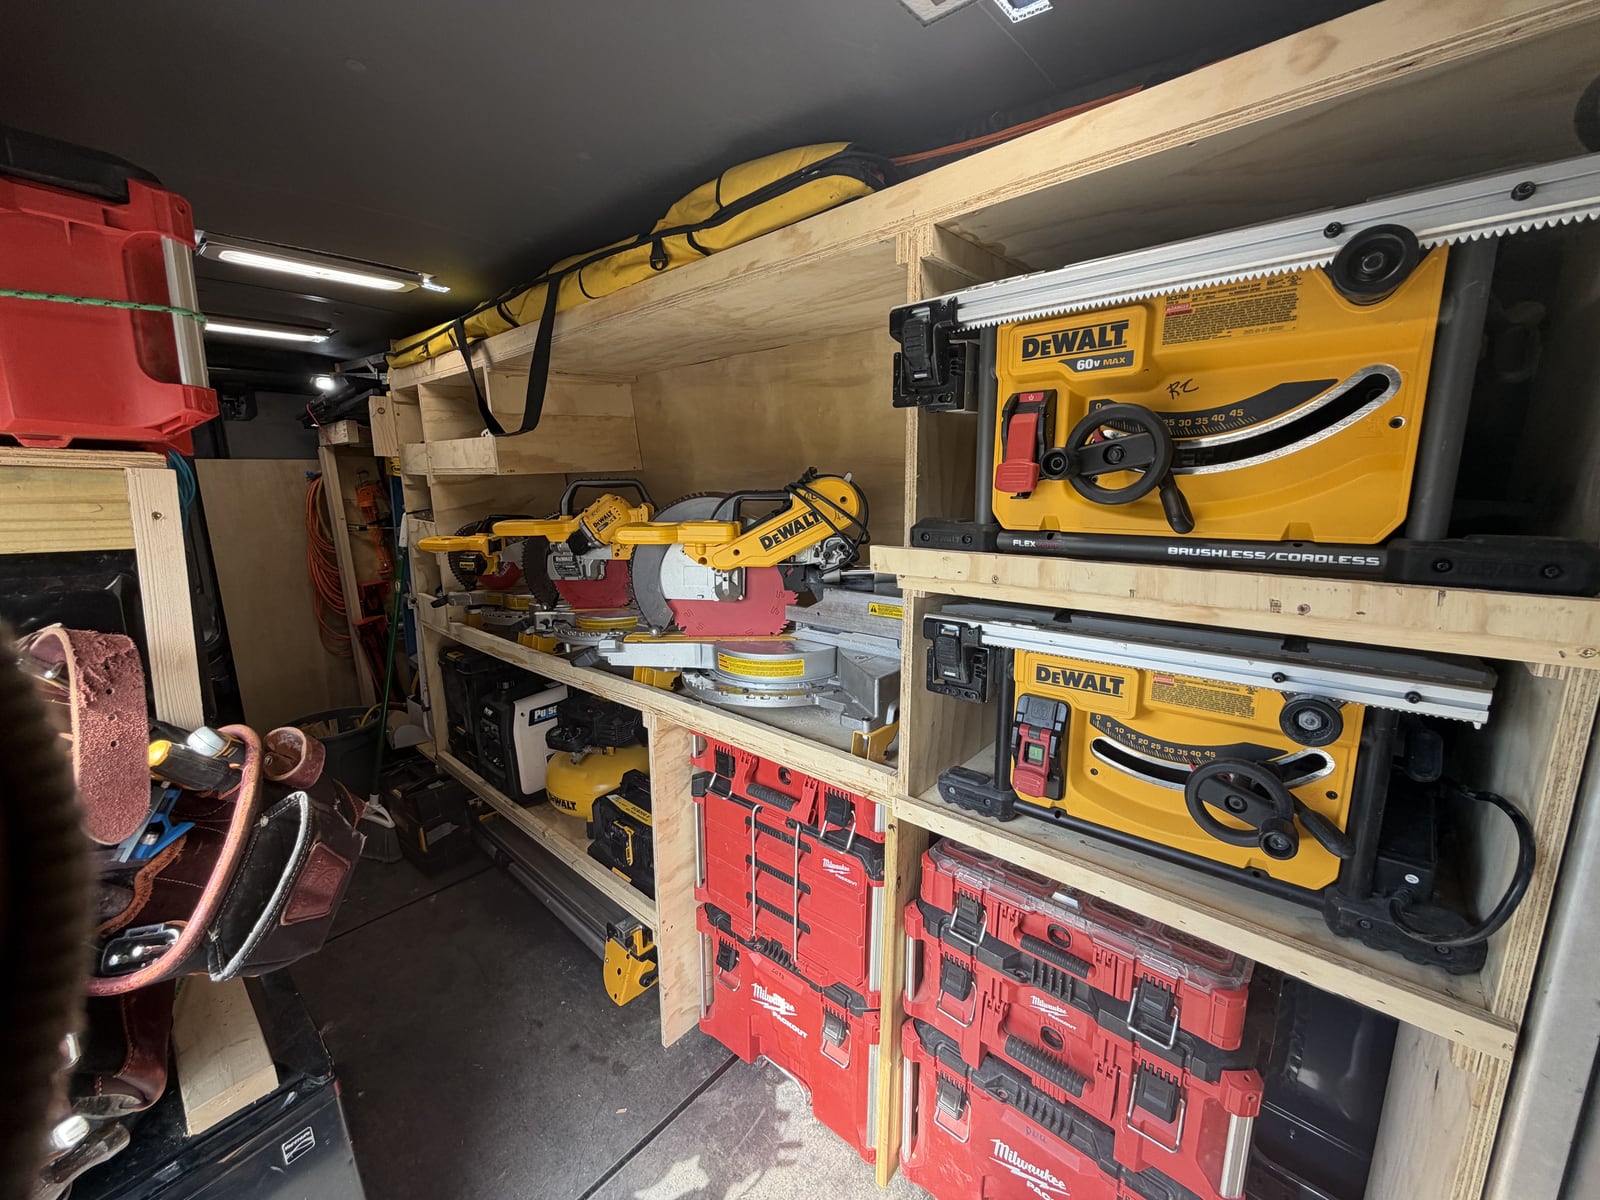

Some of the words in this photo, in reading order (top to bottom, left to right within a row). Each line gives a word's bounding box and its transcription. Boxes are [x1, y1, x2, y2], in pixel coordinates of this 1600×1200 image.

[1103, 357, 1126, 367] MAX
[1178, 418, 1191, 427] 30
[1195, 417, 1209, 425] 35
[1211, 413, 1225, 422] 40
[1229, 408, 1244, 417] 45
[1167, 546, 1380, 566] BRUSHLESS/CORDLESS
[1150, 742, 1161, 750] 25
[1163, 746, 1175, 754] 30
[1177, 748, 1188, 756] 35
[1190, 750, 1202, 758] 40
[1204, 750, 1216, 758] 45
[1030, 994, 1068, 1015] Milwaukee
[989, 1138, 1067, 1190] Milwaukee
